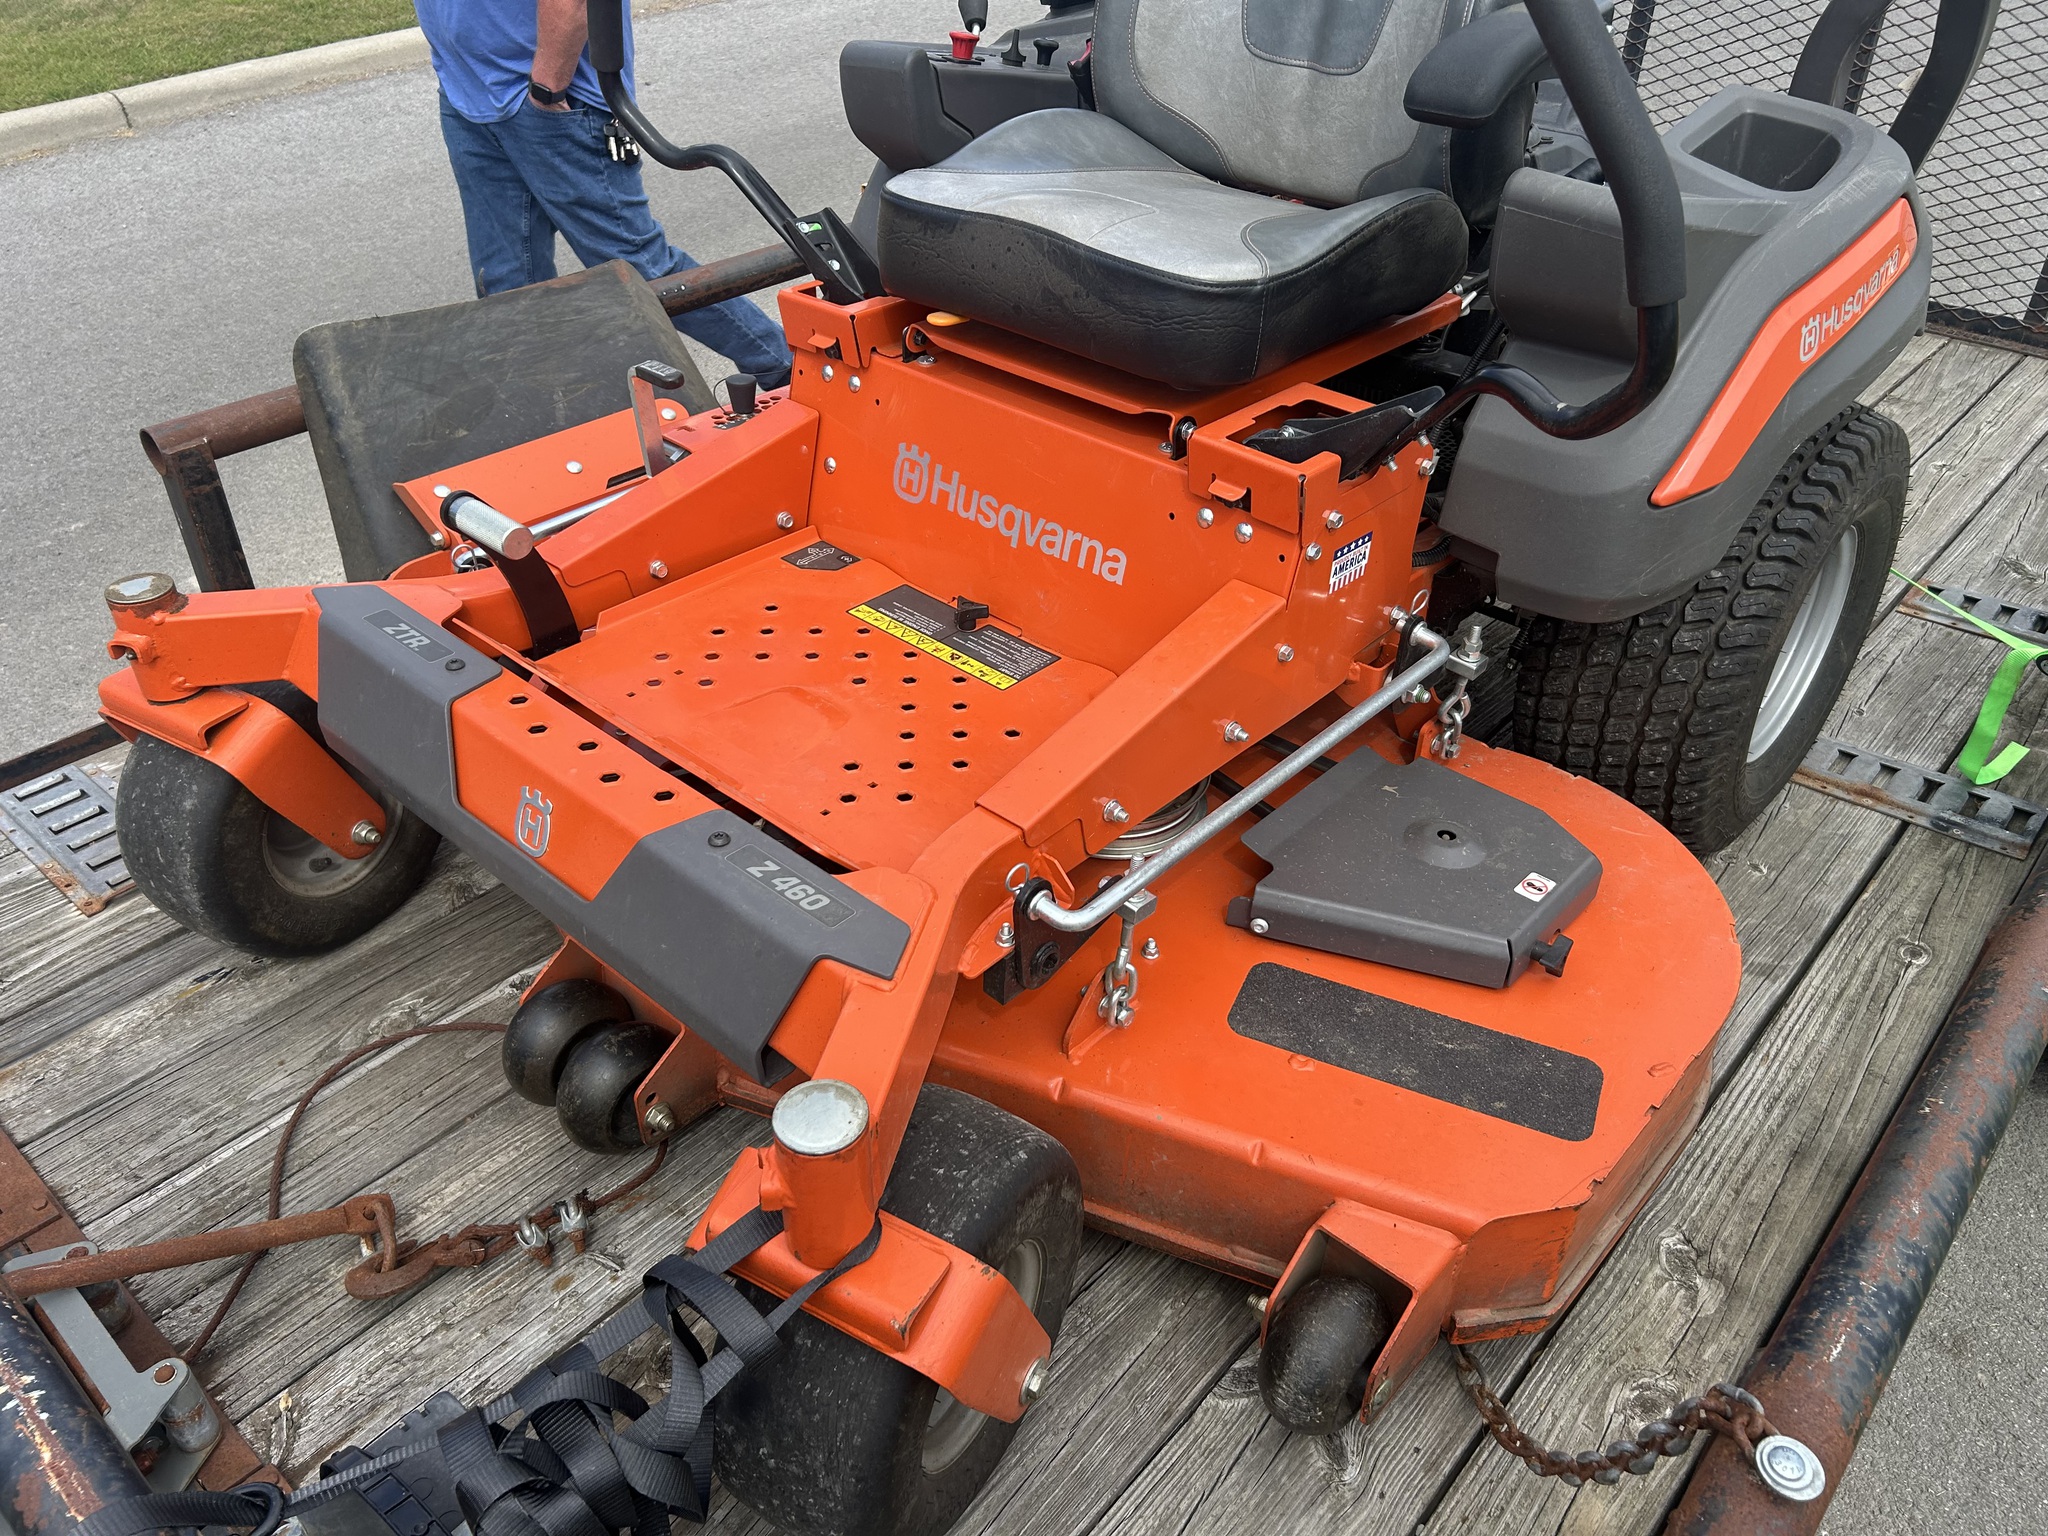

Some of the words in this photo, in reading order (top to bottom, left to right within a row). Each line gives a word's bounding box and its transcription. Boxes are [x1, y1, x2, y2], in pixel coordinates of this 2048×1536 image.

[1820, 248, 1901, 345] Husqvarna
[930, 464, 1128, 586] Husqvarna
[1332, 550, 1367, 579] AMERICA
[746, 860, 781, 878] Z
[771, 876, 831, 911] 460
